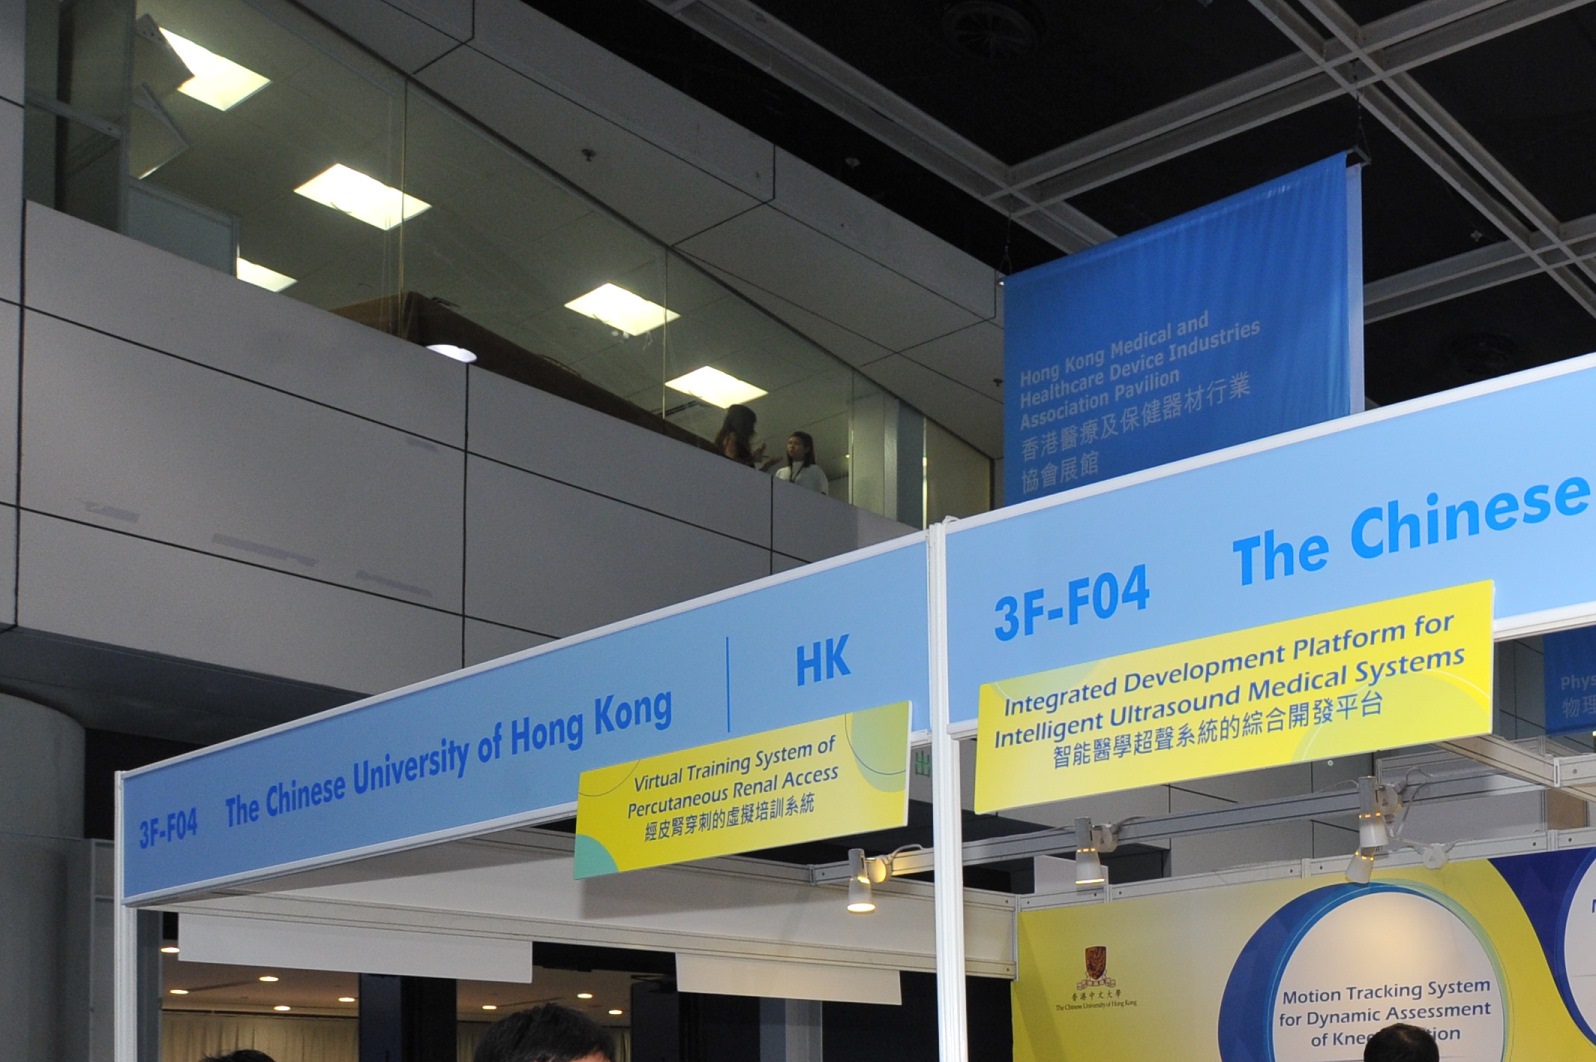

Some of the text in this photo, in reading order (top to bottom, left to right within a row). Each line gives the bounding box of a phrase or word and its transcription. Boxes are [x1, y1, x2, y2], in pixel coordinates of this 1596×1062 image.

[1020, 310, 1209, 387] Hong Kong Medical and
[1020, 320, 1261, 409] Healthcare Device Industries
[1020, 369, 1180, 431] Association Pavilion
[1021, 371, 1250, 463] 香港醫療及保健器材行業
[1021, 450, 1099, 495] 協會展館
[1232, 530, 1329, 586] The
[1350, 475, 1591, 559] Chinese
[994, 564, 1150, 642] 3F-F04
[796, 633, 851, 686] HK
[1004, 614, 1454, 717] Integrated Development Platform for
[995, 647, 1466, 749] Intelligent Ultrasound Medical Systems
[1053, 690, 1383, 770] 智能醫學超聲系統的綜合開發平台
[226, 684, 673, 828] The Chinese University of Hong Kong
[634, 735, 836, 793] Virtual Training System of
[627, 766, 839, 819] Percutaneous Renal Access
[139, 810, 198, 850] 3F-F04
[1279, 1002, 1492, 1028] for Dynamic Assessment
[1282, 979, 1491, 1005] Motion Tracking System
[1311, 1033, 1328, 1047] of
